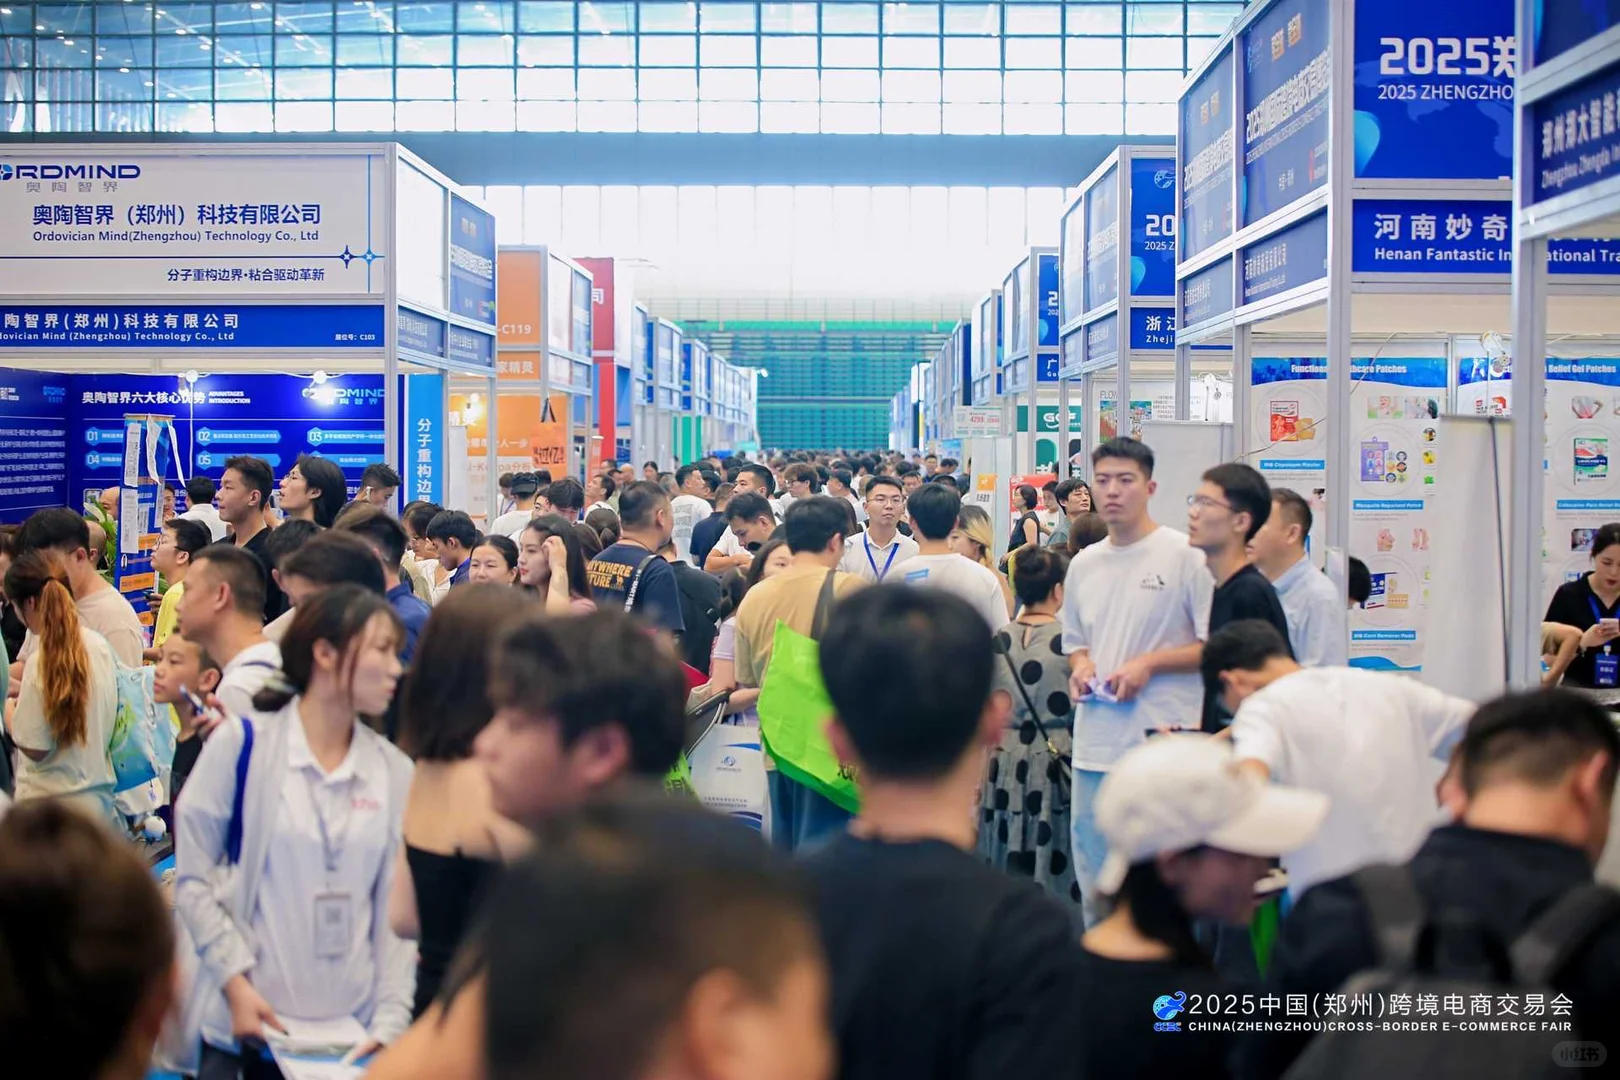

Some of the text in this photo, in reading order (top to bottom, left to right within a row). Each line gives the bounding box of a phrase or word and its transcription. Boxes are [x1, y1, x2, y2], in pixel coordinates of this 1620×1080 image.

[1378, 85, 1416, 100] 2025
[26, 181, 118, 193] 奥陶智界
[1374, 213, 1509, 241] 河南妙奇
[33, 230, 319, 243] Ordovician Mind(Zhengzhou) Technology Co., Ltd
[1144, 241, 1166, 251] 2025
[1375, 248, 1422, 261] Henan
[1426, 247, 1494, 261] Fantastic
[42, 332, 66, 340] Mind
[69, 332, 131, 342] (Zhengzhou)
[134, 332, 192, 343] Technology
[195, 332, 215, 342] Co.,
[218, 332, 235, 340] Ltd
[1375, 364, 1407, 373] Patches
[1586, 364, 1617, 373] Patches
[87, 431, 98, 441] 01
[198, 431, 210, 441] 02
[309, 431, 322, 441] 03
[87, 455, 100, 464] 04
[198, 455, 211, 464] 05
[588, 560, 633, 577] NYWHERE
